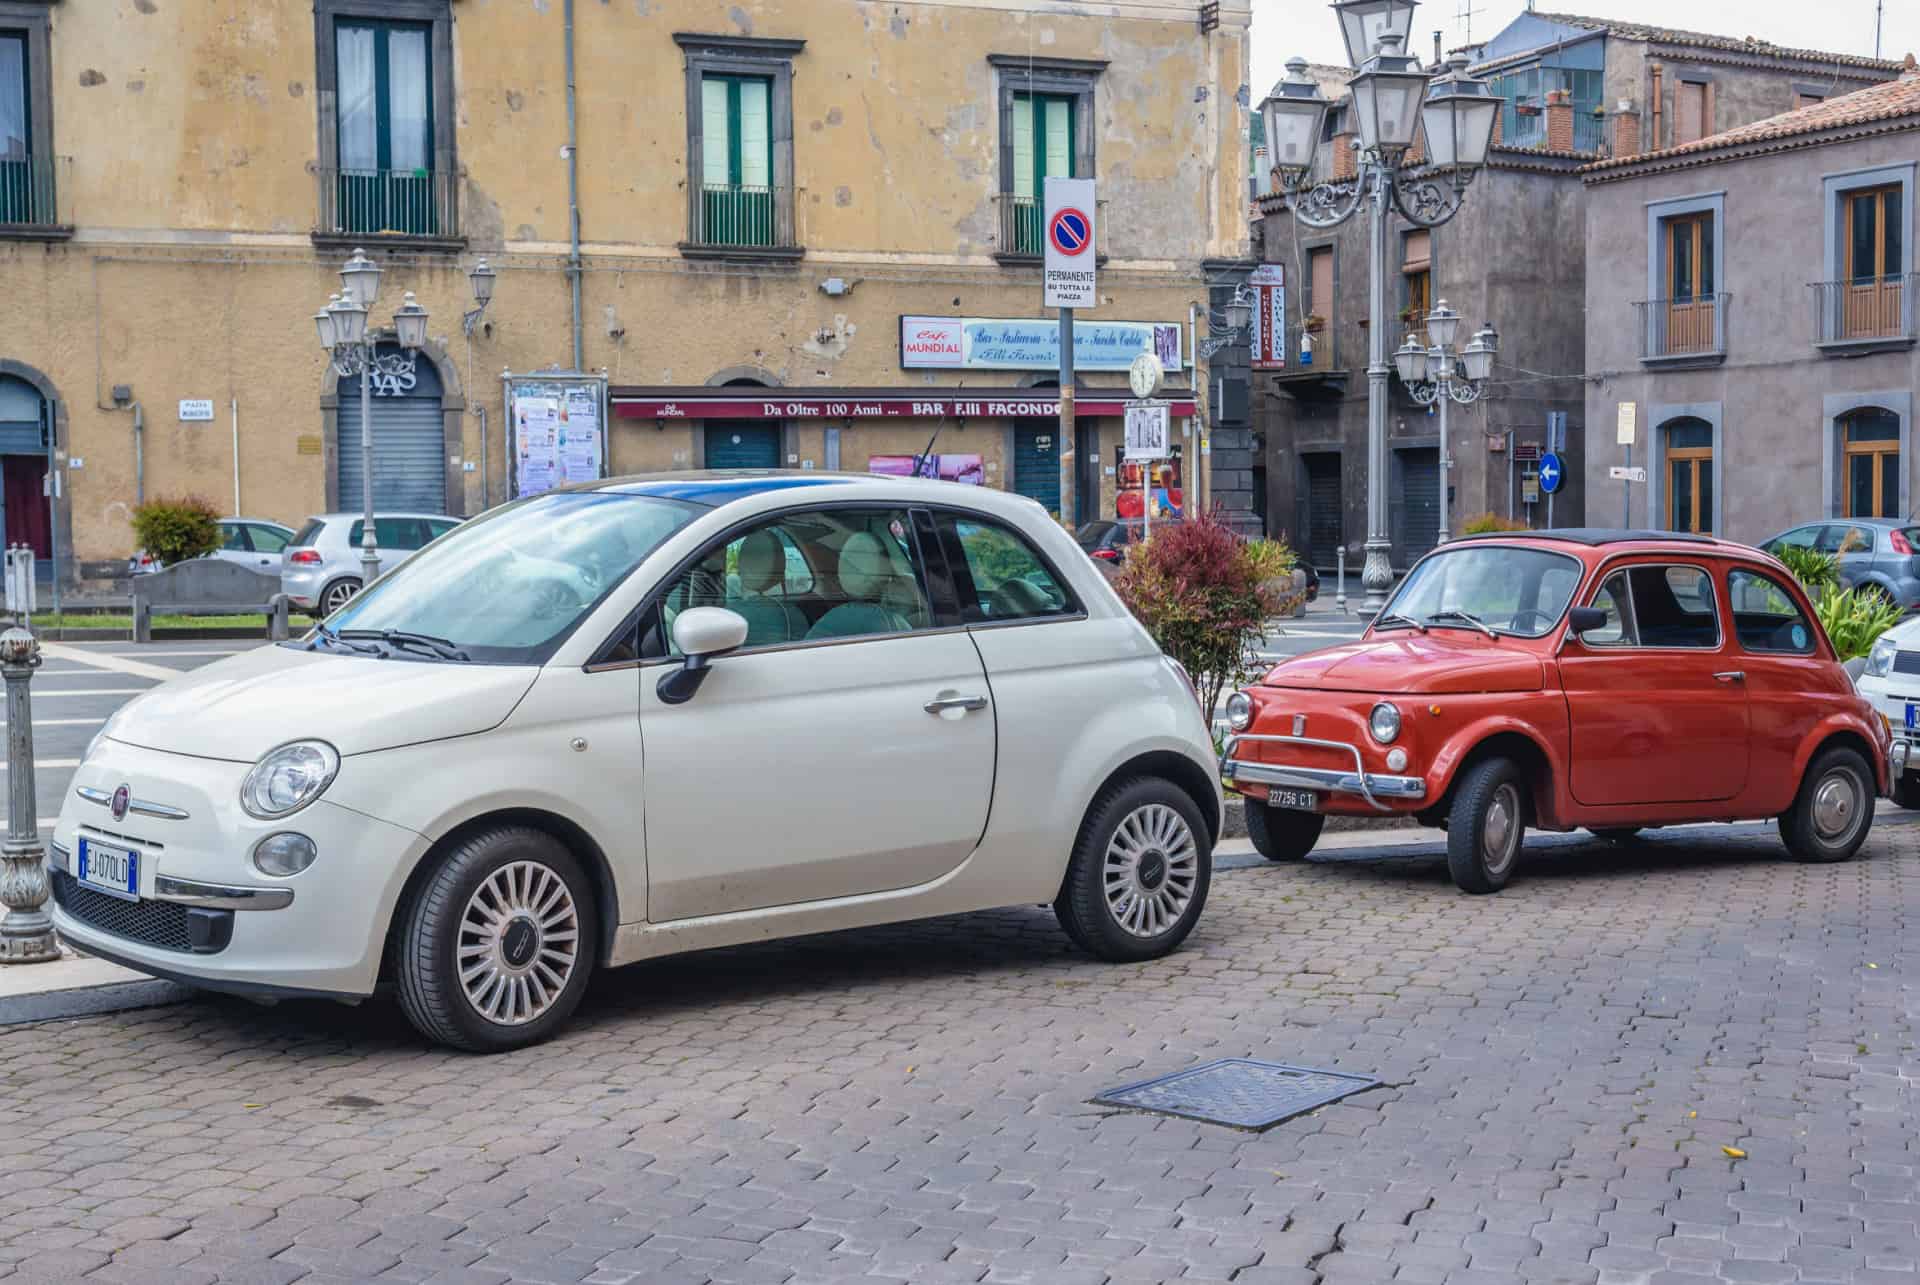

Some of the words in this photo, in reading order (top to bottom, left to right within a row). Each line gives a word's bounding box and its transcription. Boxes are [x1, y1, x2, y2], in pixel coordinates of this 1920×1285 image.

[1047, 270, 1095, 282] PERMANENTE
[1262, 292, 1271, 352] GELATERIA
[906, 343, 961, 353] MUNDIAL
[764, 403, 782, 416] Da
[786, 403, 819, 416] Oltre
[826, 403, 848, 416] 100
[852, 403, 882, 416] Anni
[912, 403, 945, 415] BAR
